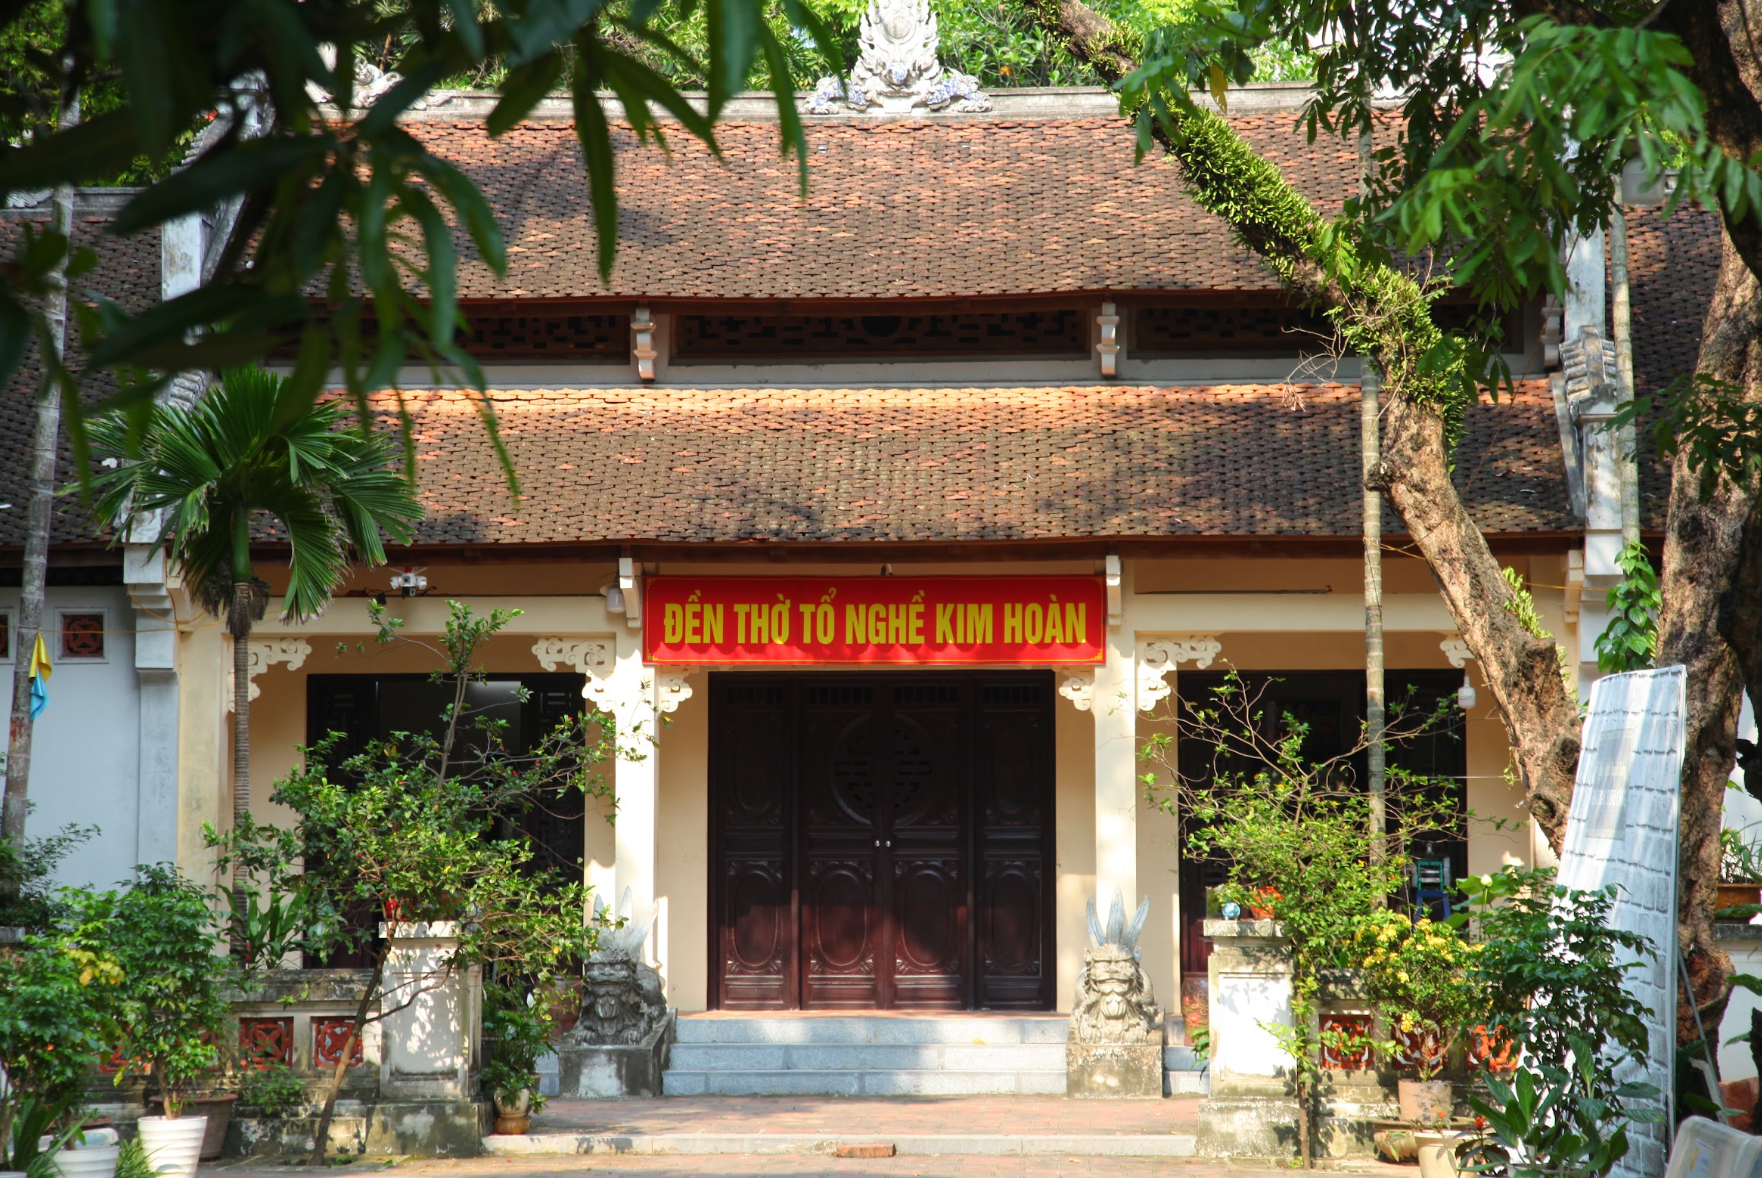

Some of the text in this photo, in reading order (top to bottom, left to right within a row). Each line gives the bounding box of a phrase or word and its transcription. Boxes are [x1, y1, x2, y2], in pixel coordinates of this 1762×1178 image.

[663, 587, 1087, 645] ĐỀN THỜ TỔ NGHỀ KIM HOÀN
